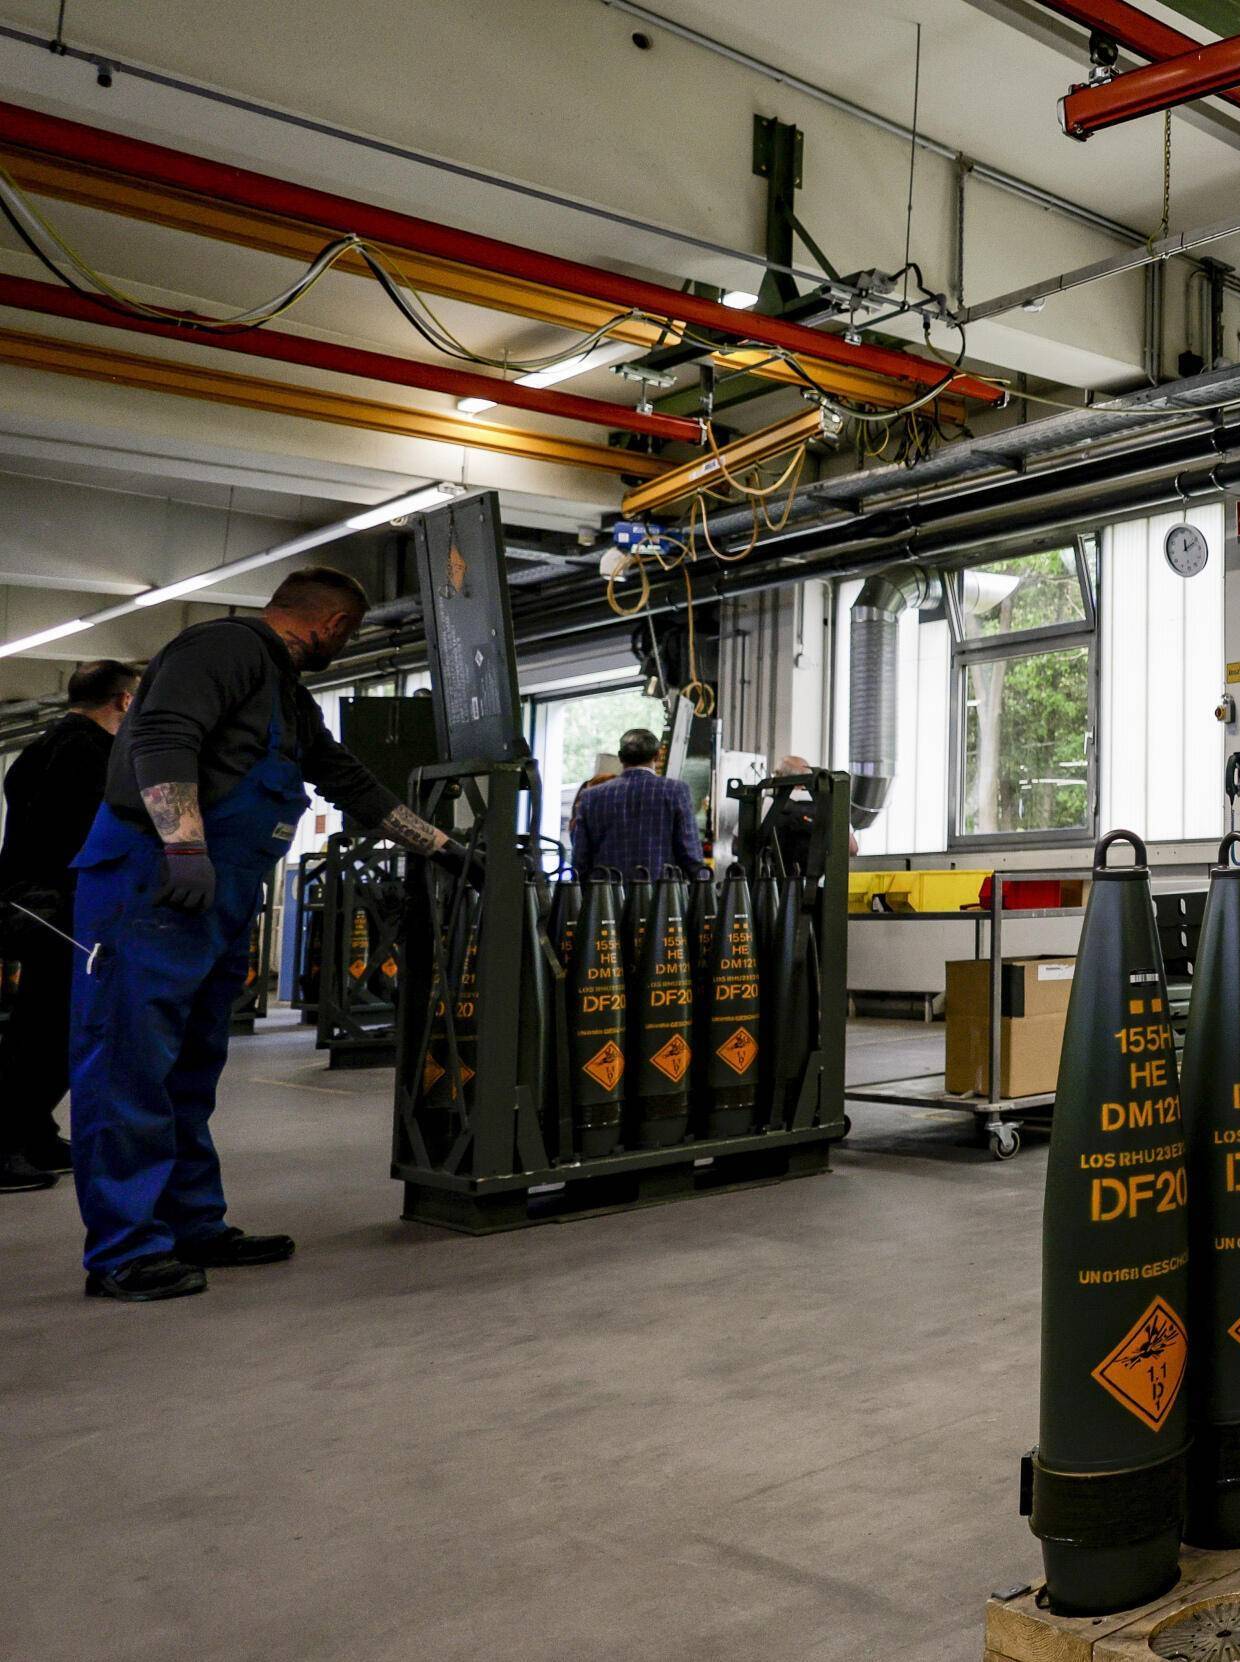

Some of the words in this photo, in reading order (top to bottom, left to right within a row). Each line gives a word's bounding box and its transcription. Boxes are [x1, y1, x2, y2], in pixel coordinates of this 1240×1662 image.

[600, 952, 617, 964] HE
[667, 950, 684, 960] HE
[732, 945, 750, 955] HE
[651, 988, 693, 1007] DF20
[716, 983, 759, 1000] DF20
[583, 994, 626, 1013] DF20
[1114, 1024, 1172, 1054] 155H
[1130, 1059, 1167, 1090] HE
[1080, 1153, 1116, 1169] LOS
[1090, 1166, 1188, 1222] DF20
[1215, 1237, 1236, 1250] UN
[1079, 1270, 1100, 1285] UN
